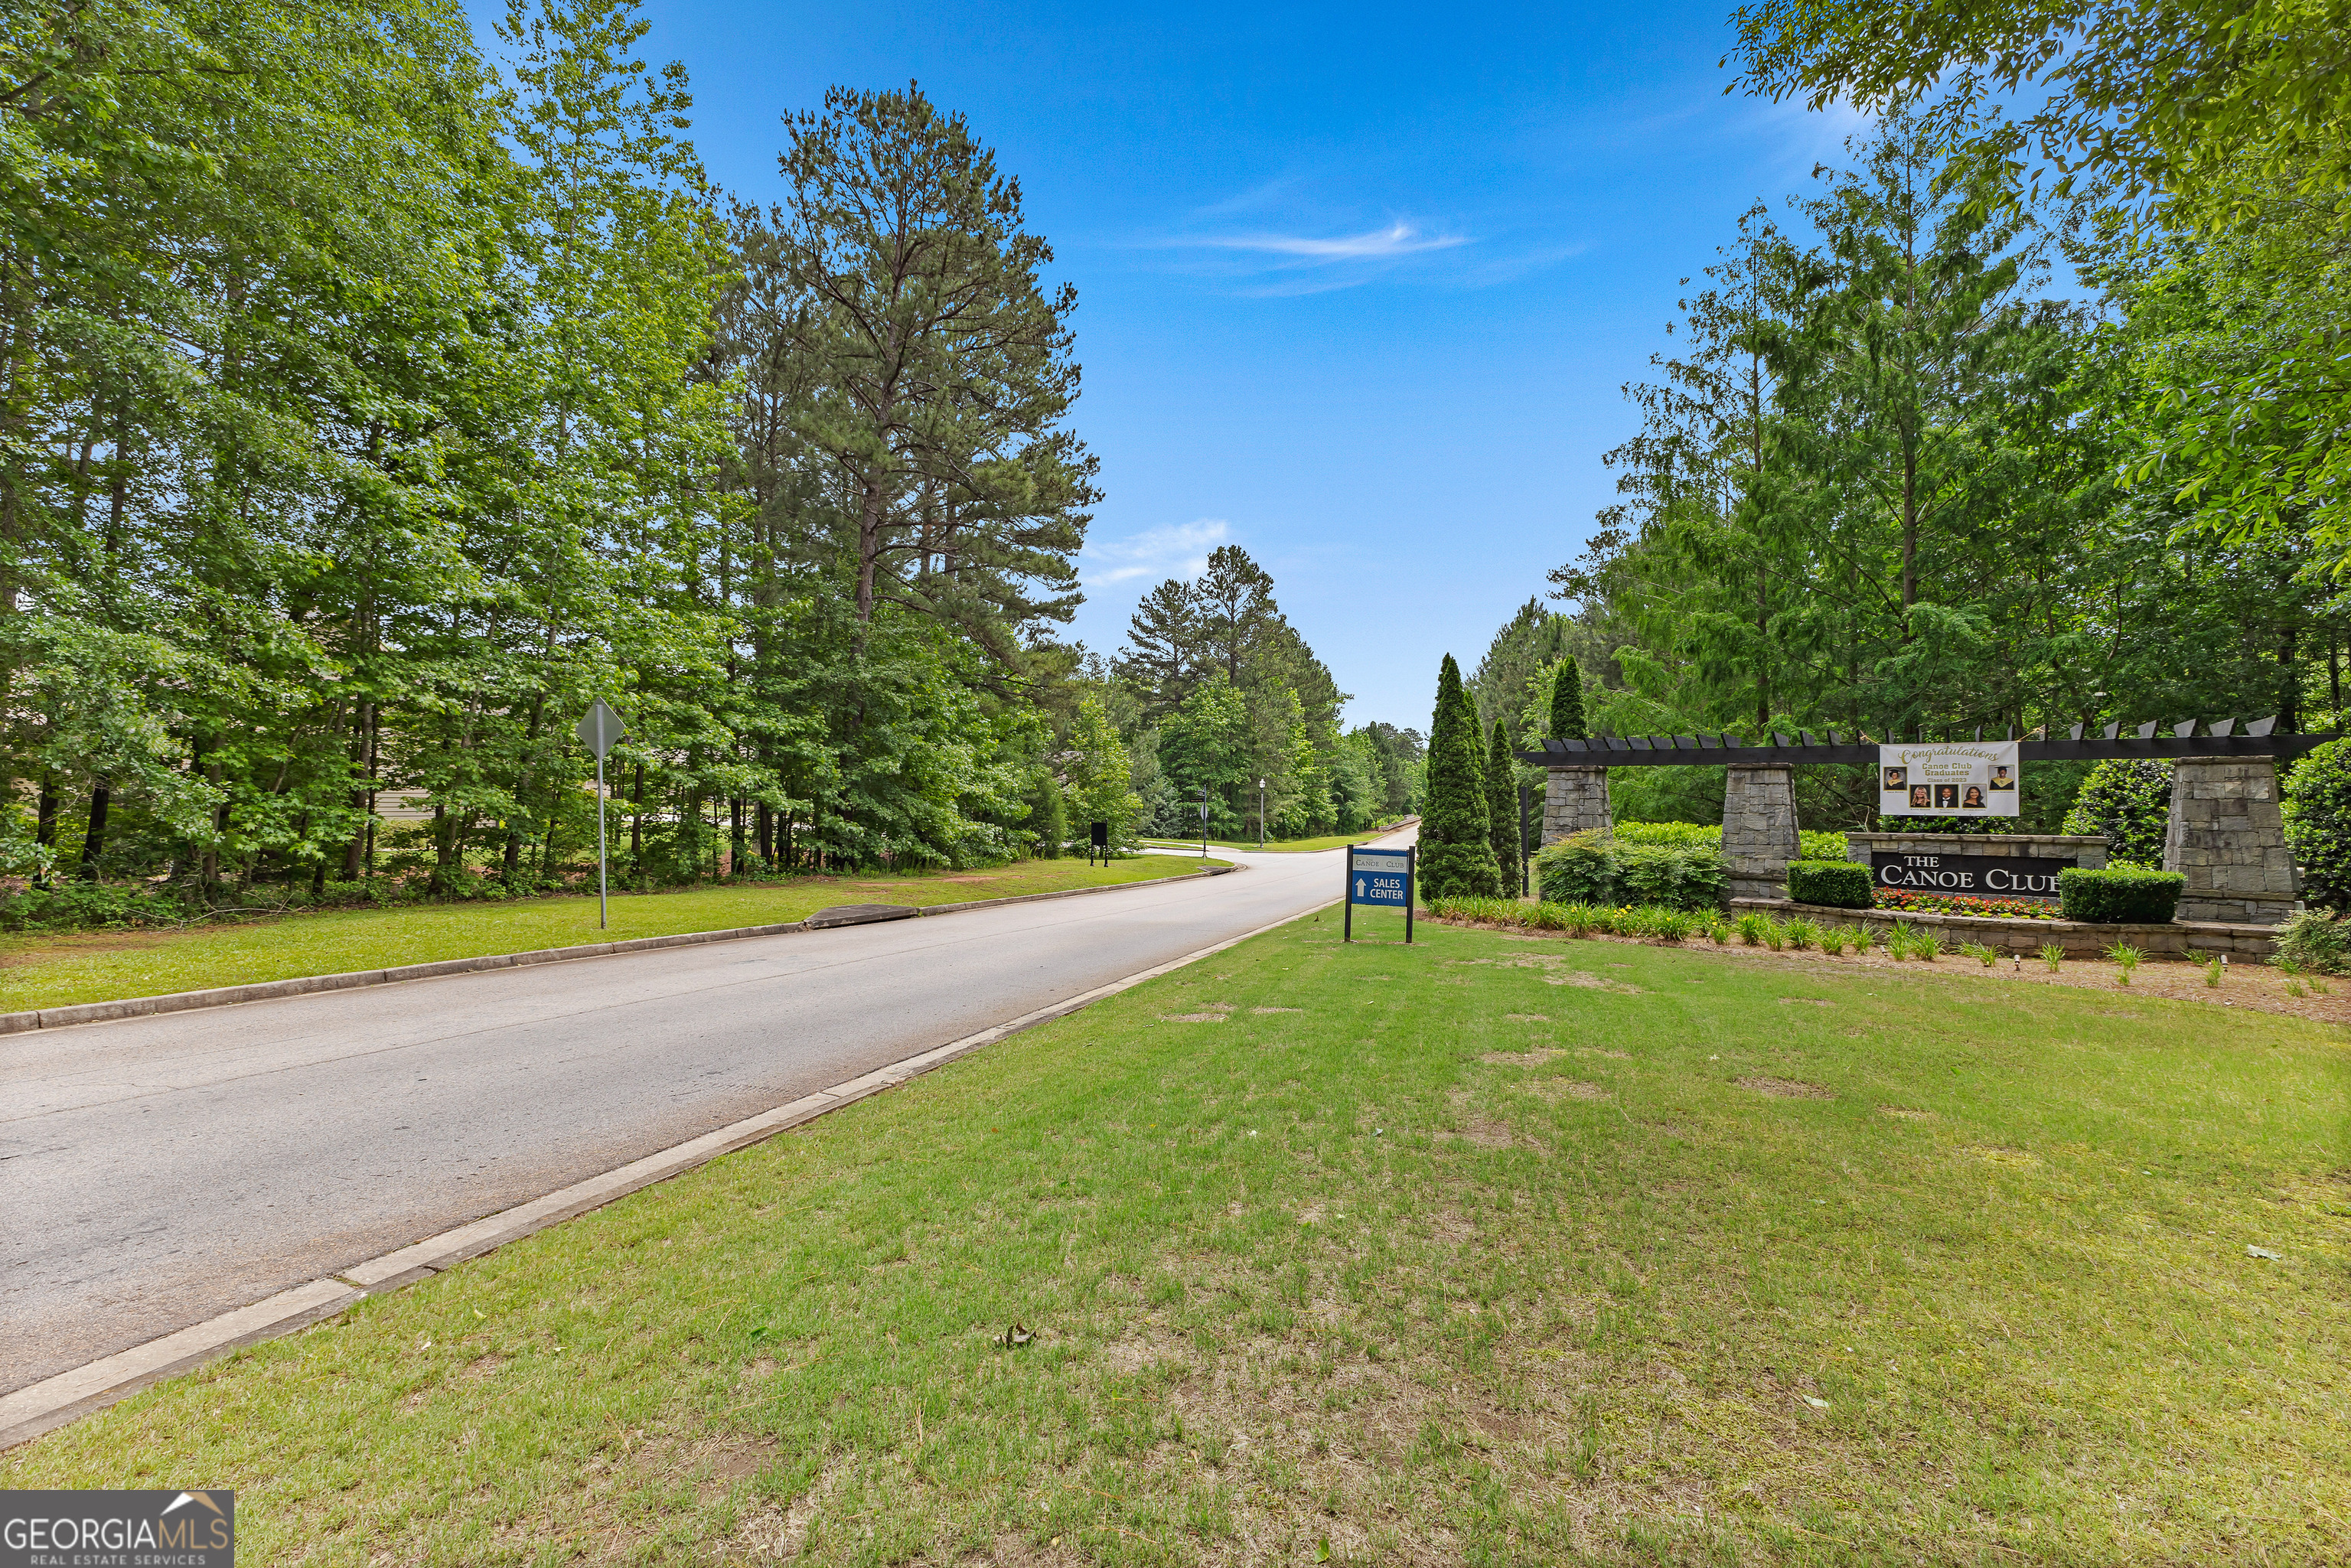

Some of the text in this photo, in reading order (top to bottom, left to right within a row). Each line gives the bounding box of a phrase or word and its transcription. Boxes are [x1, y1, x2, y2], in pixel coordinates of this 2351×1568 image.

[1898, 746, 1999, 764] Congratulations
[1903, 856, 1939, 868] THE
[1880, 865, 1974, 888] CANOE
[1374, 878, 1400, 888] SALES
[1370, 888, 1403, 899] CENTER
